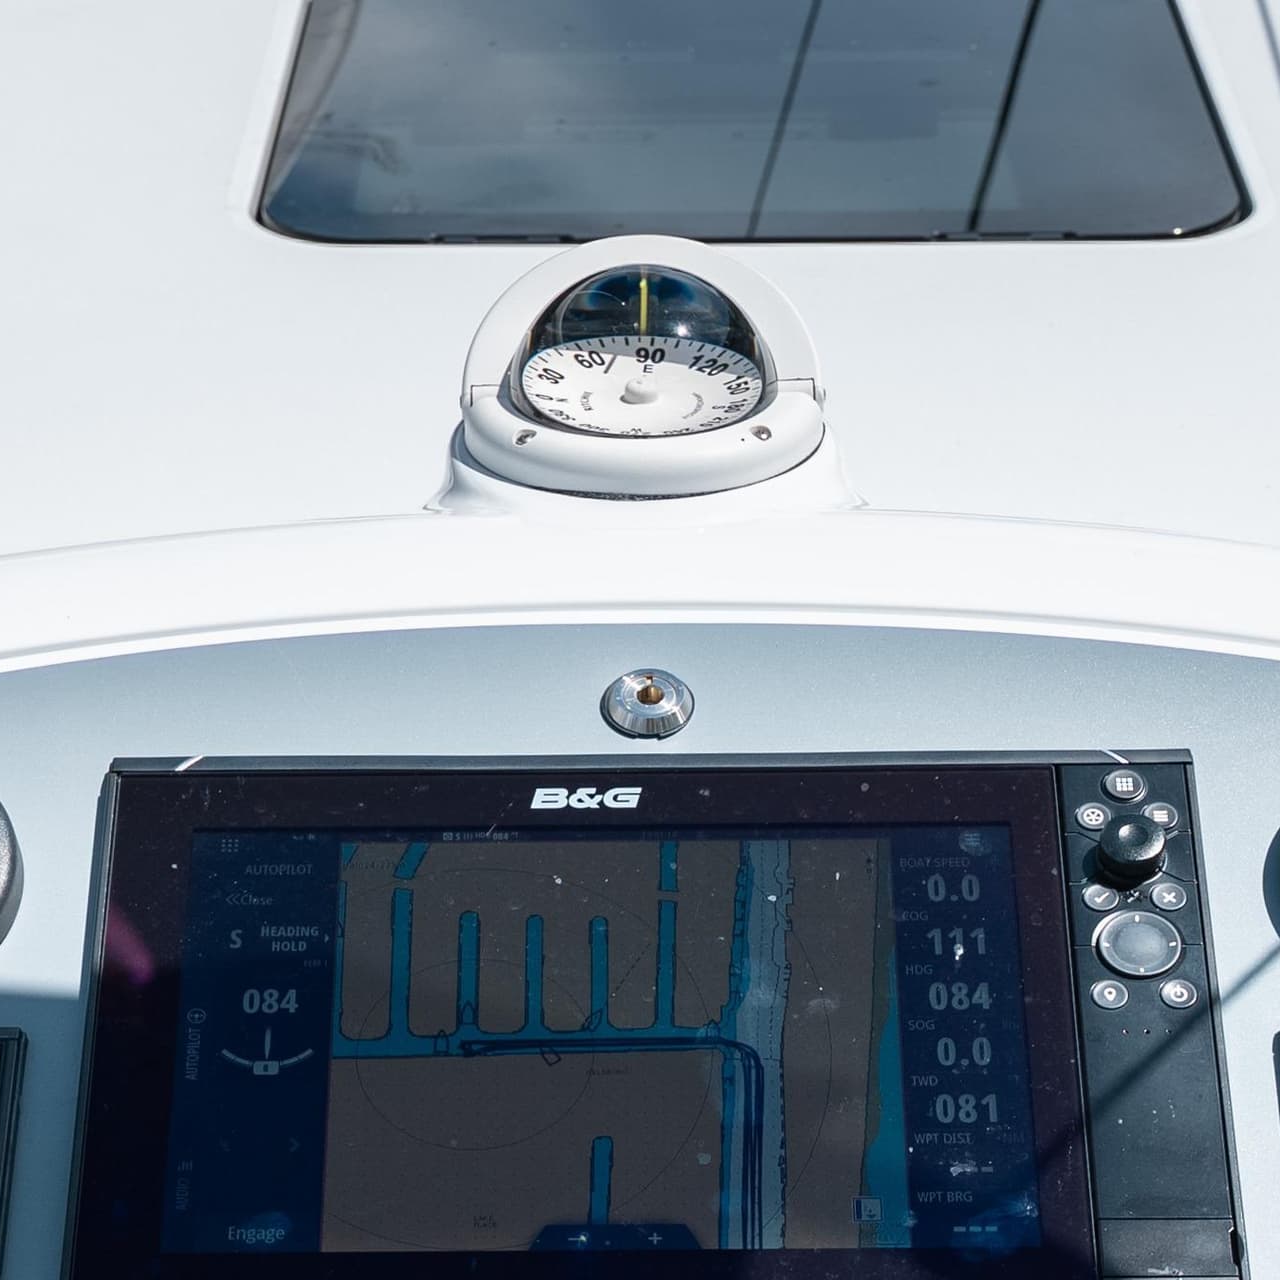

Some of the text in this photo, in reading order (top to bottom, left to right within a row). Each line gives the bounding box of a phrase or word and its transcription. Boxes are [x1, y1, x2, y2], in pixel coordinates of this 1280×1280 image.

[574, 350, 606, 369] 60
[636, 347, 666, 364] 90
[642, 364, 654, 374] E
[688, 354, 729, 377] 120
[538, 367, 565, 385] 30
[723, 375, 750, 396] 150
[530, 787, 642, 809] B&G
[245, 864, 313, 876] AUTOPILOT
[927, 874, 980, 902] 0.0
[902, 911, 929, 921] COG
[229, 930, 242, 948] S
[260, 926, 320, 937] HEADING
[272, 942, 307, 952] HOLD
[926, 928, 986, 956] 111
[905, 965, 934, 976] HDG
[242, 989, 298, 1014] 084
[928, 982, 992, 1010] 084
[908, 1020, 936, 1030] SOG
[184, 1028, 201, 1080] AUTOPILOT
[937, 1037, 992, 1066] 0.0
[912, 1076, 938, 1086] TWD
[936, 1094, 998, 1124] 081
[914, 1133, 939, 1144] WPT
[918, 1192, 973, 1202] WPT BRG
[228, 1226, 286, 1244] Engage
